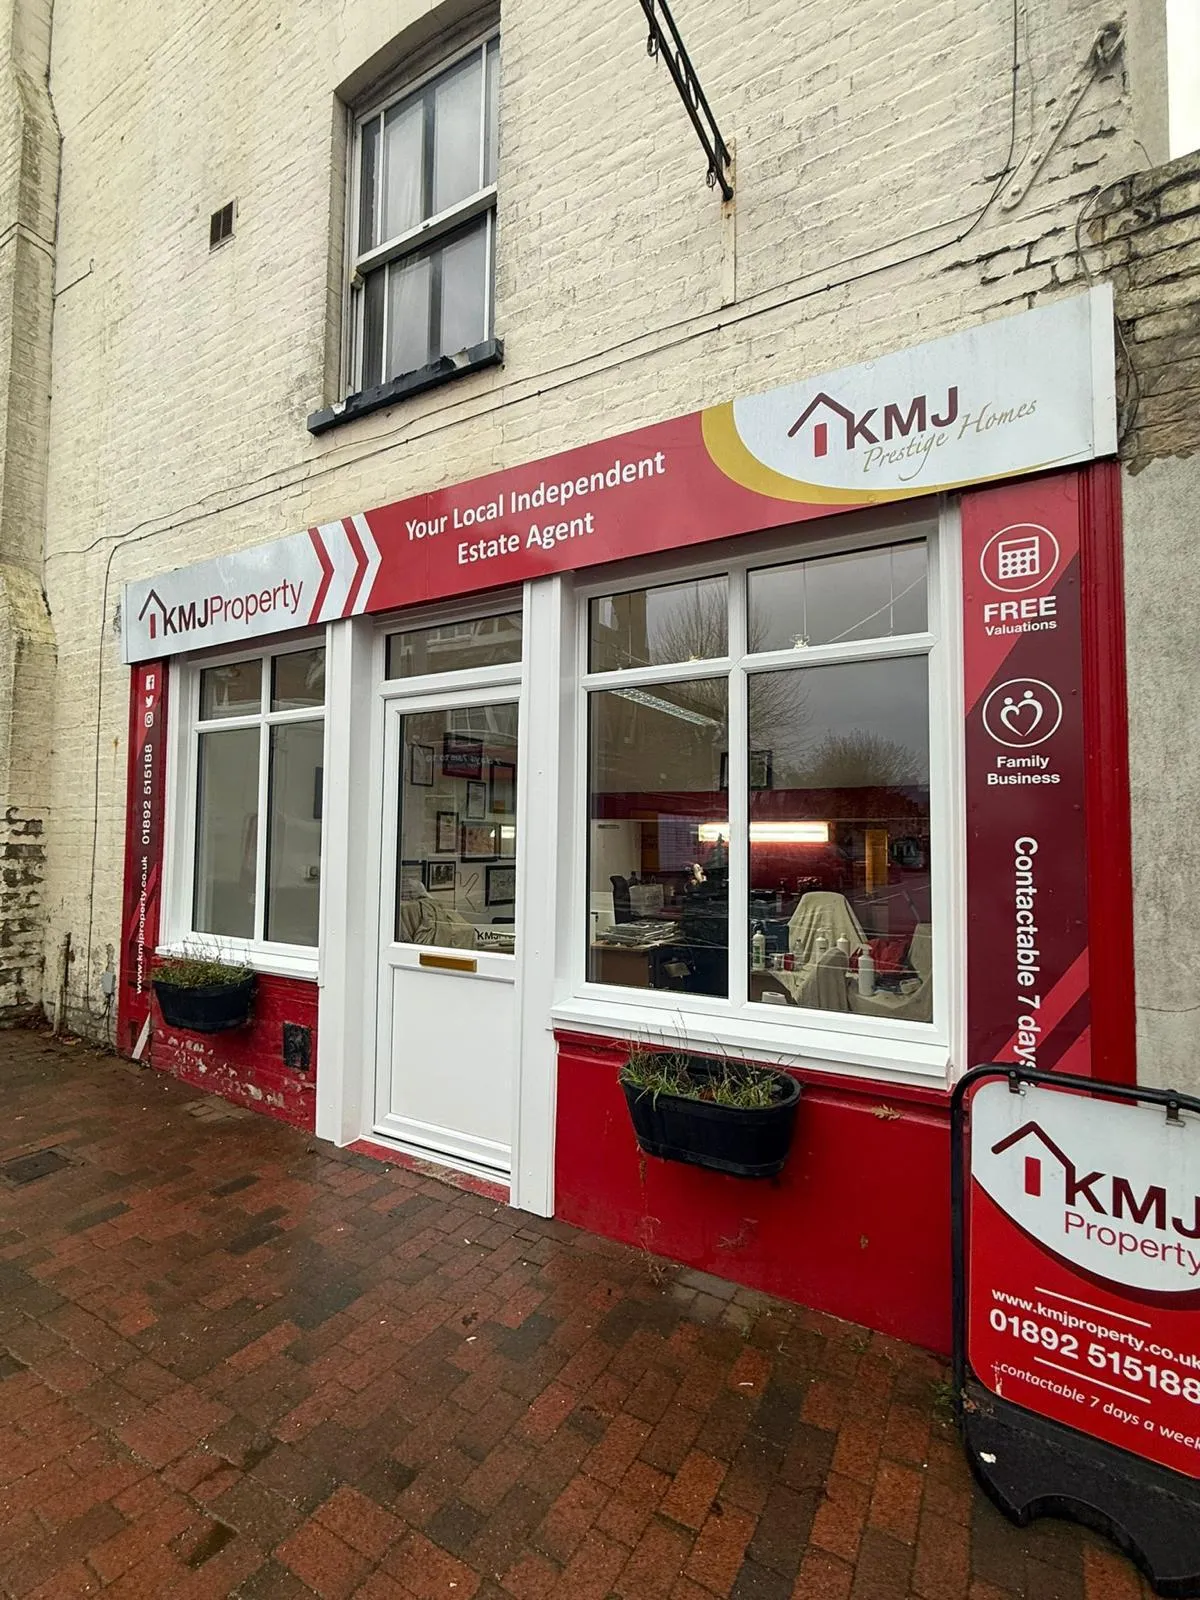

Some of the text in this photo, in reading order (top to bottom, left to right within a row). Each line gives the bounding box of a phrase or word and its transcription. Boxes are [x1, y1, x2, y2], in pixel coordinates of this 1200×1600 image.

[847, 386, 958, 449] KMJ
[863, 399, 1037, 481] Prestige Homes
[405, 451, 666, 540] Your Local Independent
[458, 512, 595, 564] Estate Agent
[983, 595, 1057, 623] FREE
[985, 620, 1057, 636] Valuations
[987, 767, 1060, 785] Business
[997, 754, 1050, 769] Family
[136, 744, 153, 994] www.kmjproperty.co.uk 01892 515188
[1014, 836, 1040, 987] Contactable
[1017, 995, 1040, 1009] 7
[1065, 1166, 1200, 1239] KMJ
[1065, 1211, 1200, 1276] Property
[989, 1308, 1200, 1405] 01892 515188
[991, 1289, 1200, 1369] www.kmjproperty.co.uk
[1000, 1363, 1085, 1404] contactable
[1090, 1396, 1100, 1407] 7
[1103, 1402, 1140, 1425] days
[1143, 1420, 1155, 1431] a
